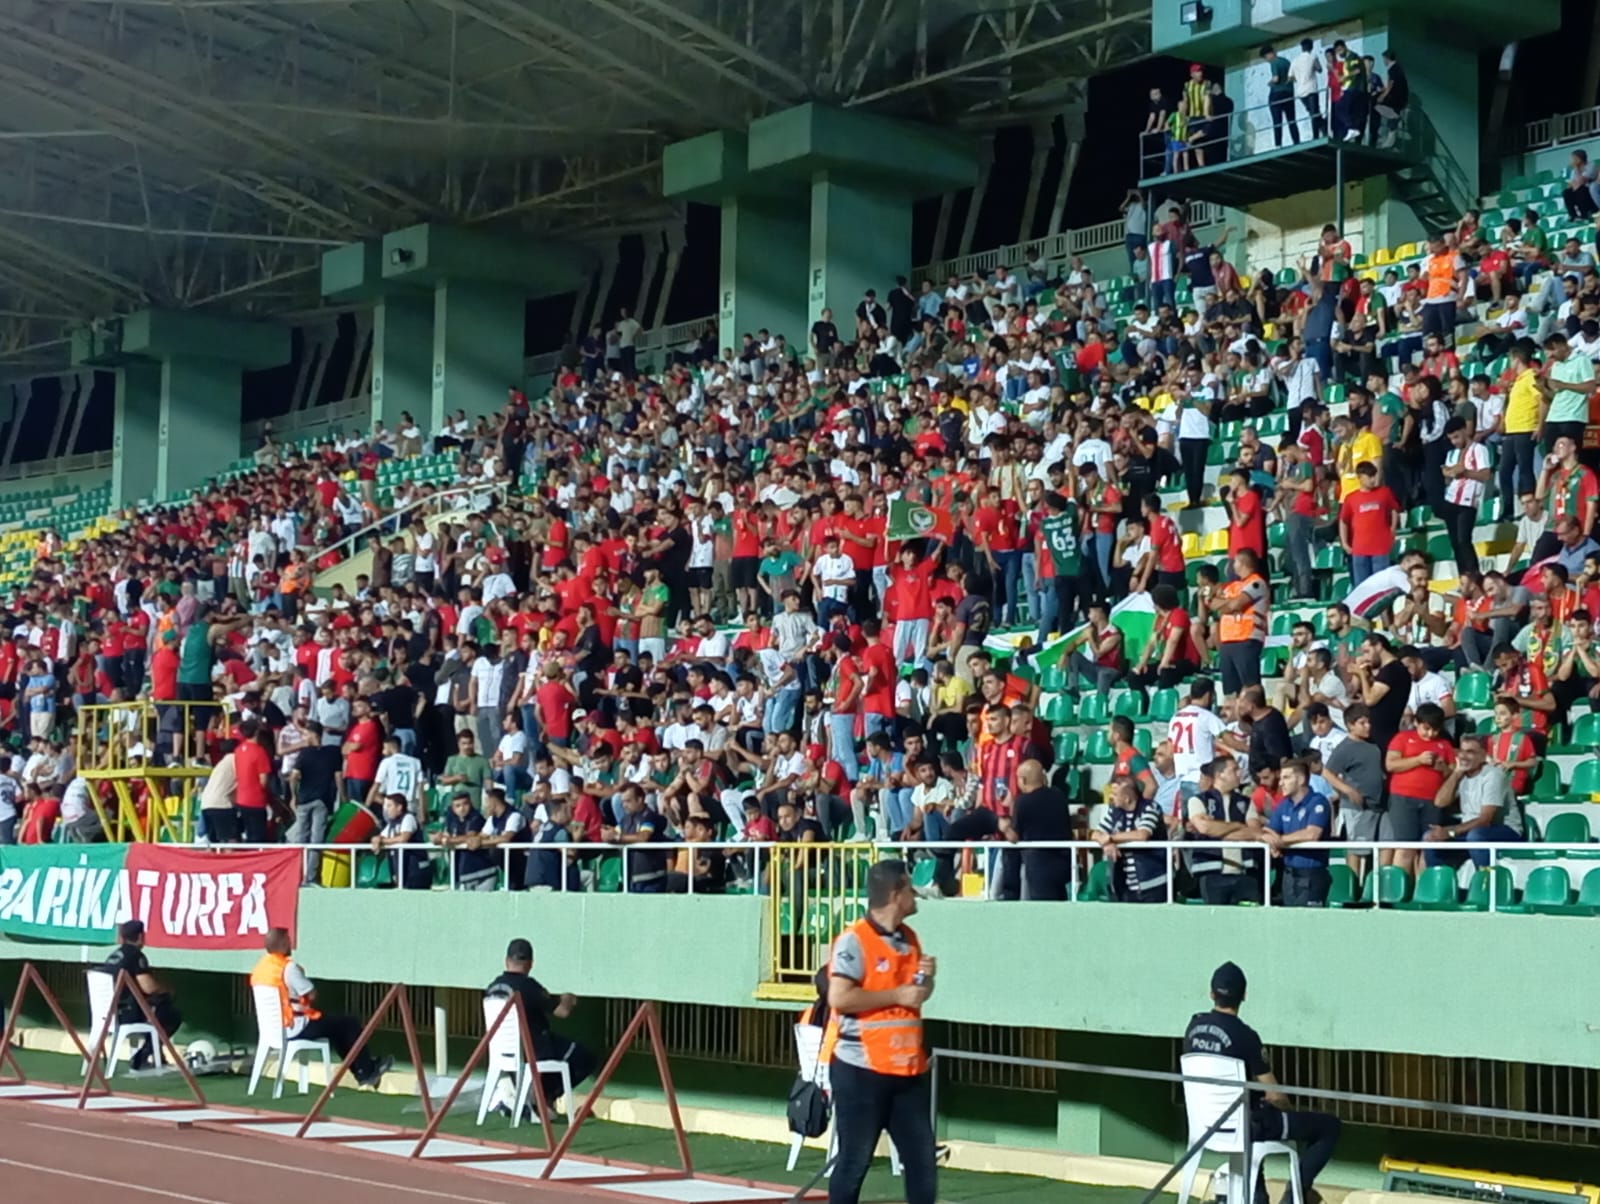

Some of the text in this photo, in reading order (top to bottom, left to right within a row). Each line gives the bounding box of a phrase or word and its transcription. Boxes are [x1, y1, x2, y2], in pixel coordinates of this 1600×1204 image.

[813, 269, 821, 287] F
[723, 291, 731, 309] F
[1052, 527, 1076, 551] 63
[1172, 721, 1195, 754] 21
[397, 770, 410, 791] 21
